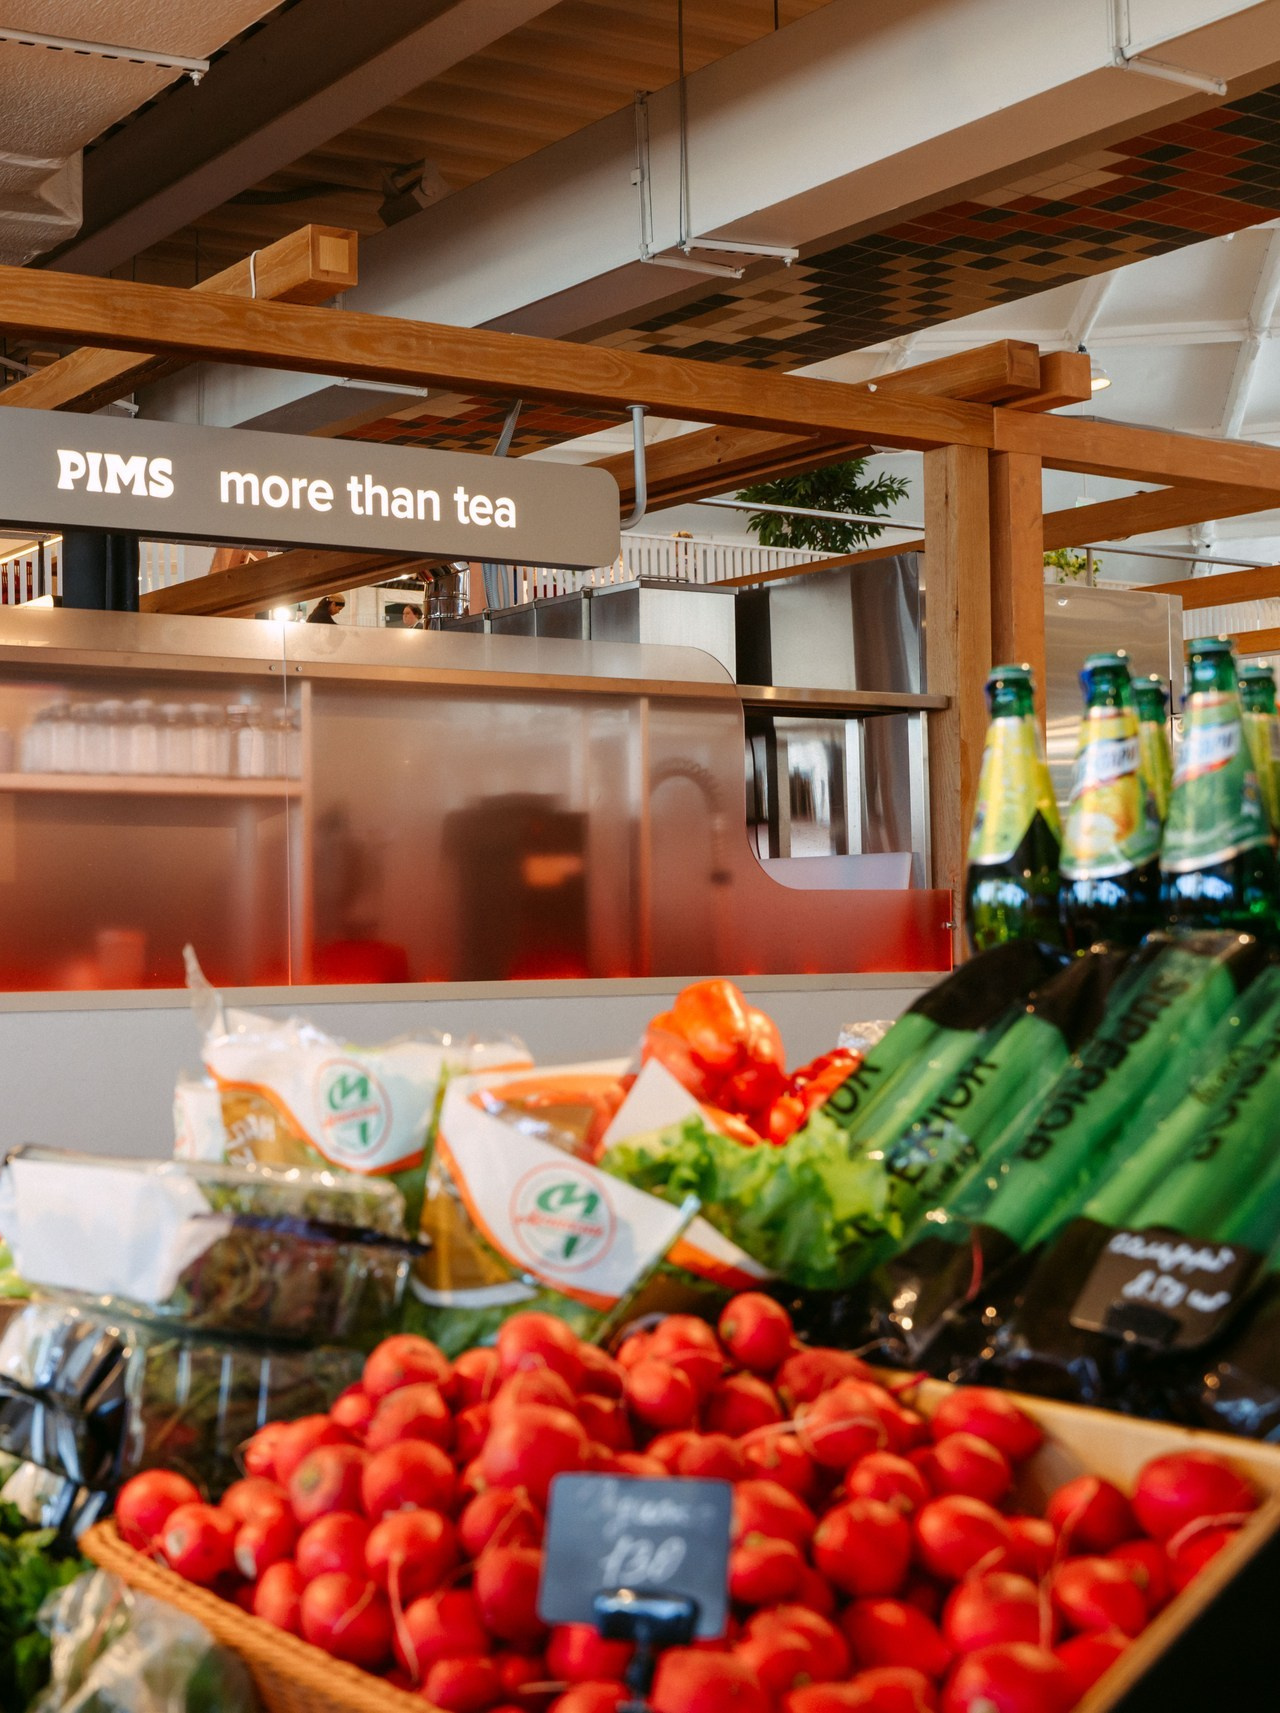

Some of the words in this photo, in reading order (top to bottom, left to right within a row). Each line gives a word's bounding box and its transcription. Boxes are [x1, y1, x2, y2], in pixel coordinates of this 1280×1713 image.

[56, 449, 175, 499] PIMS
[220, 470, 334, 512] more
[347, 474, 441, 522] than
[453, 486, 517, 528] tea
